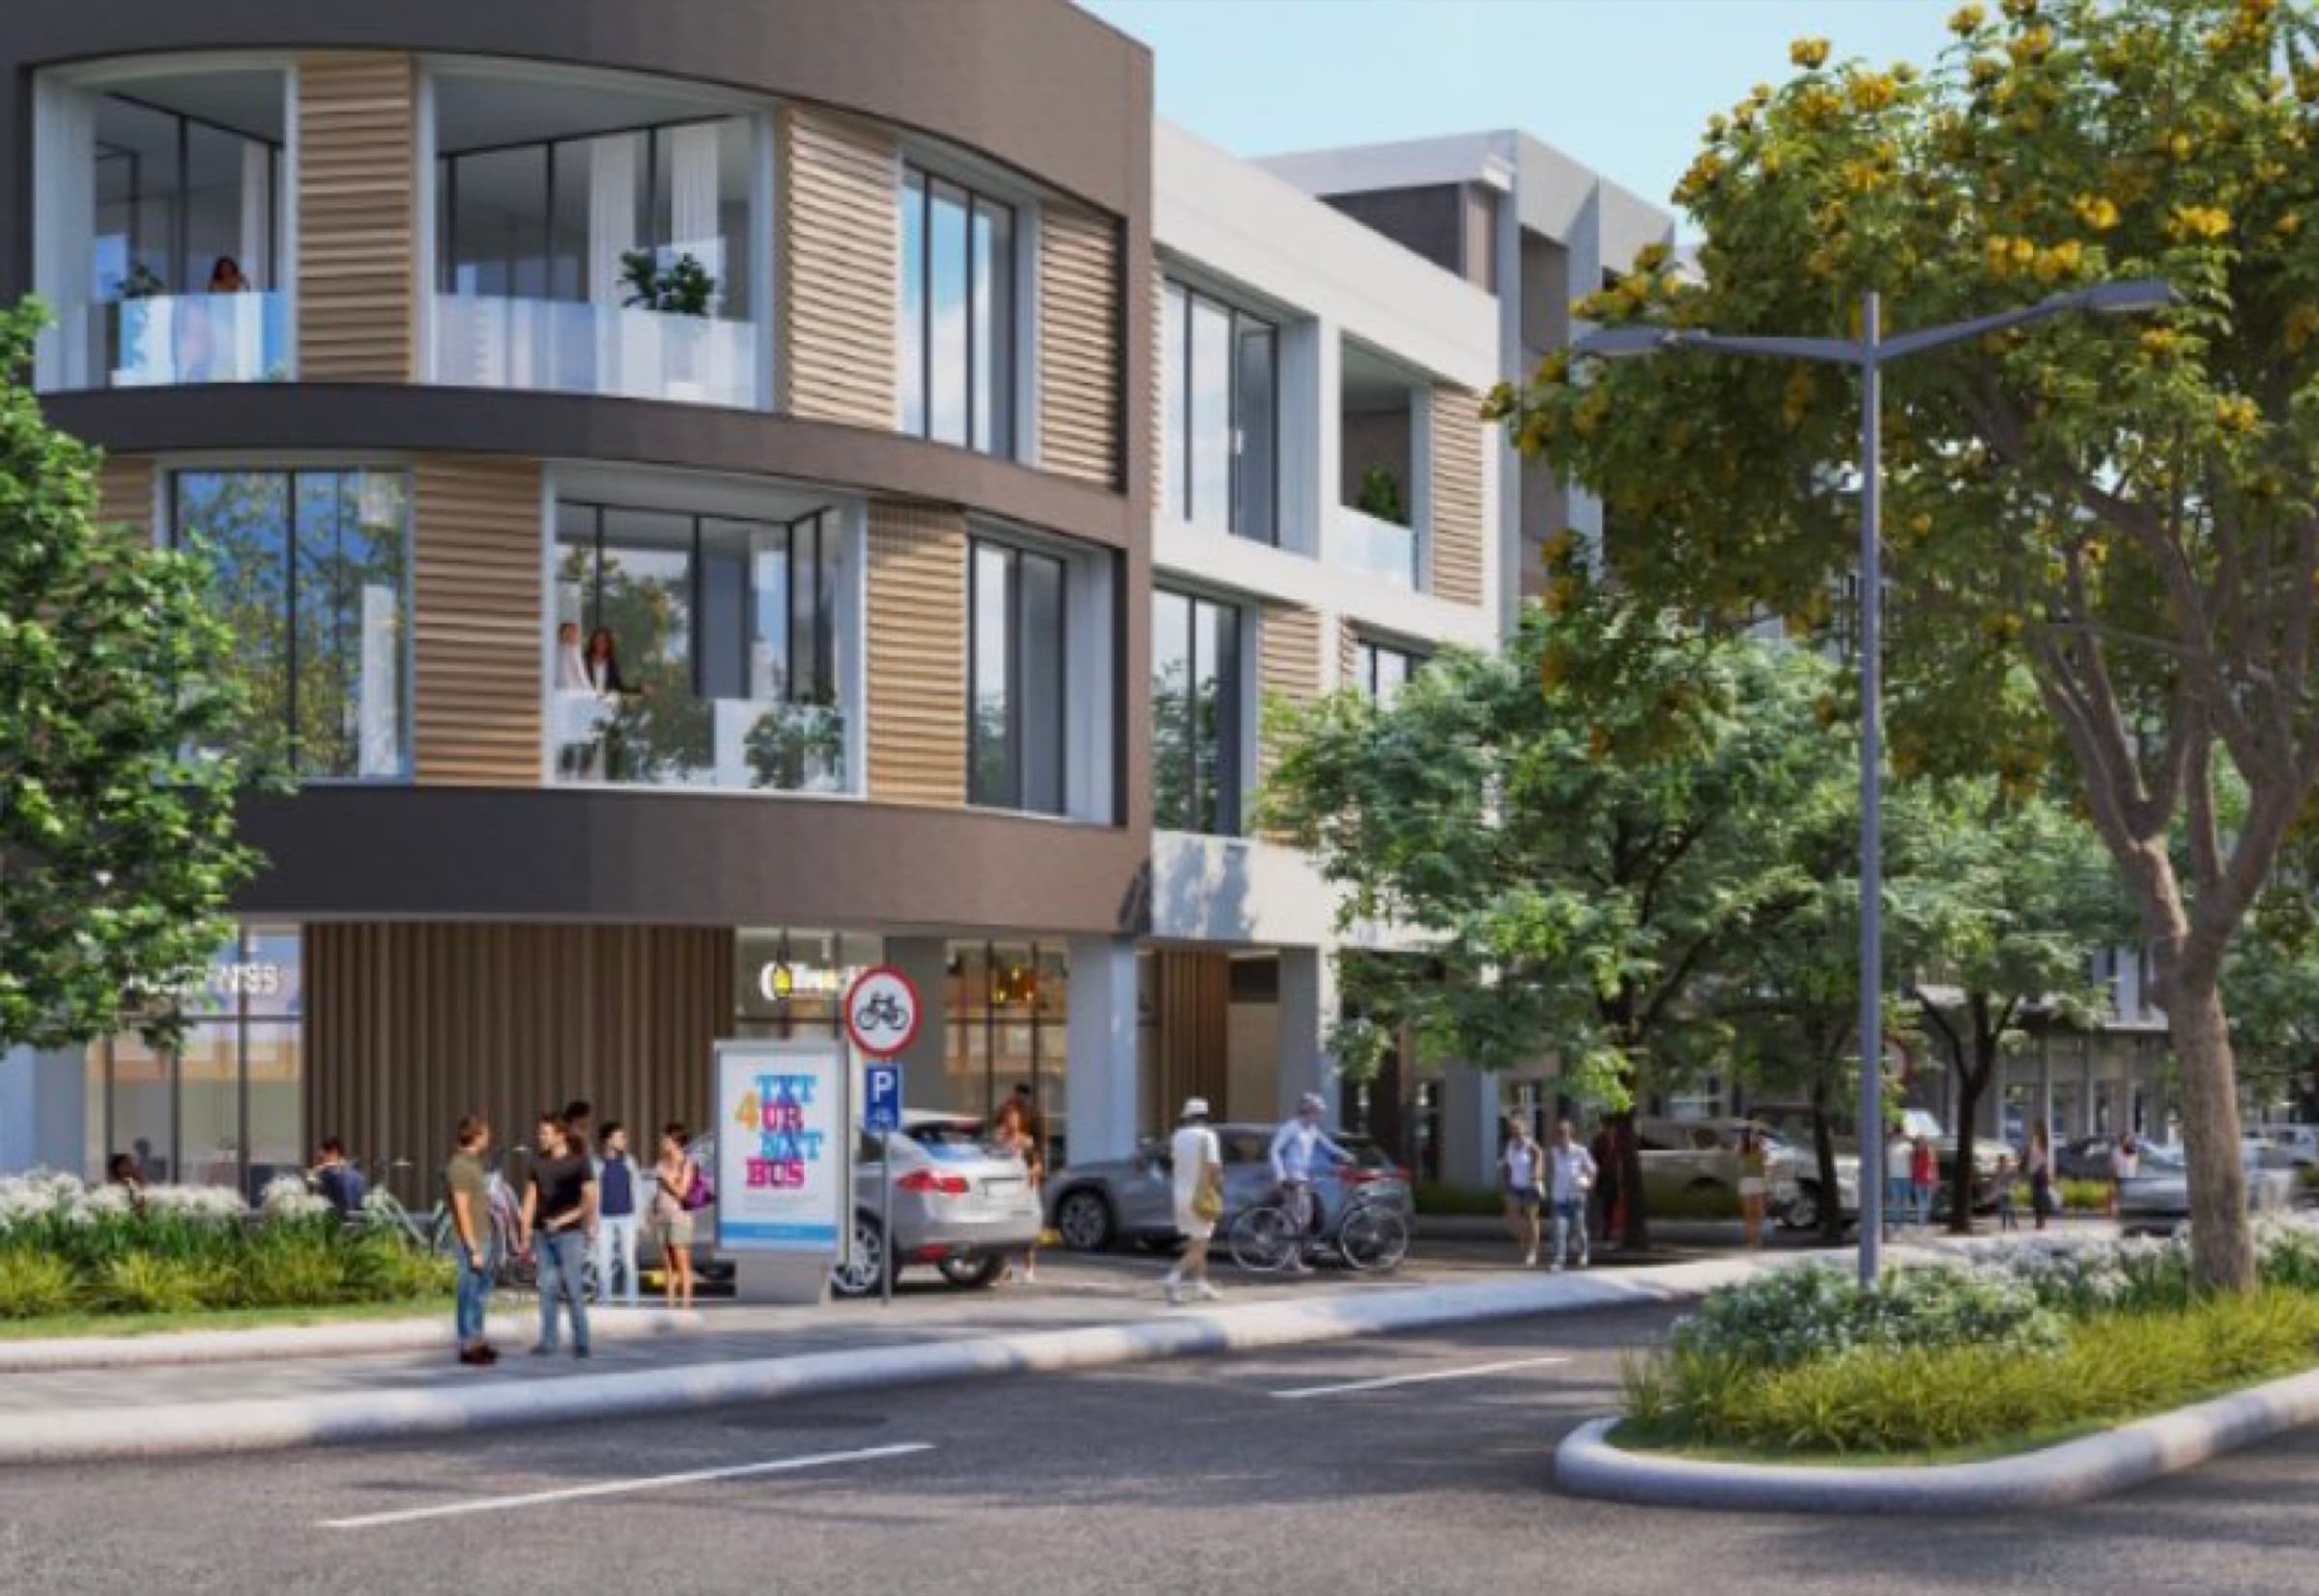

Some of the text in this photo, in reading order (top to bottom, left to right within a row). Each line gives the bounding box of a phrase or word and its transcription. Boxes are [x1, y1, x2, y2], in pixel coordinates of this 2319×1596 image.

[756, 1074, 817, 1104] TXT
[873, 1070, 895, 1102] P
[735, 1089, 804, 1131] 4 UR
[746, 1158, 805, 1188] BUS
